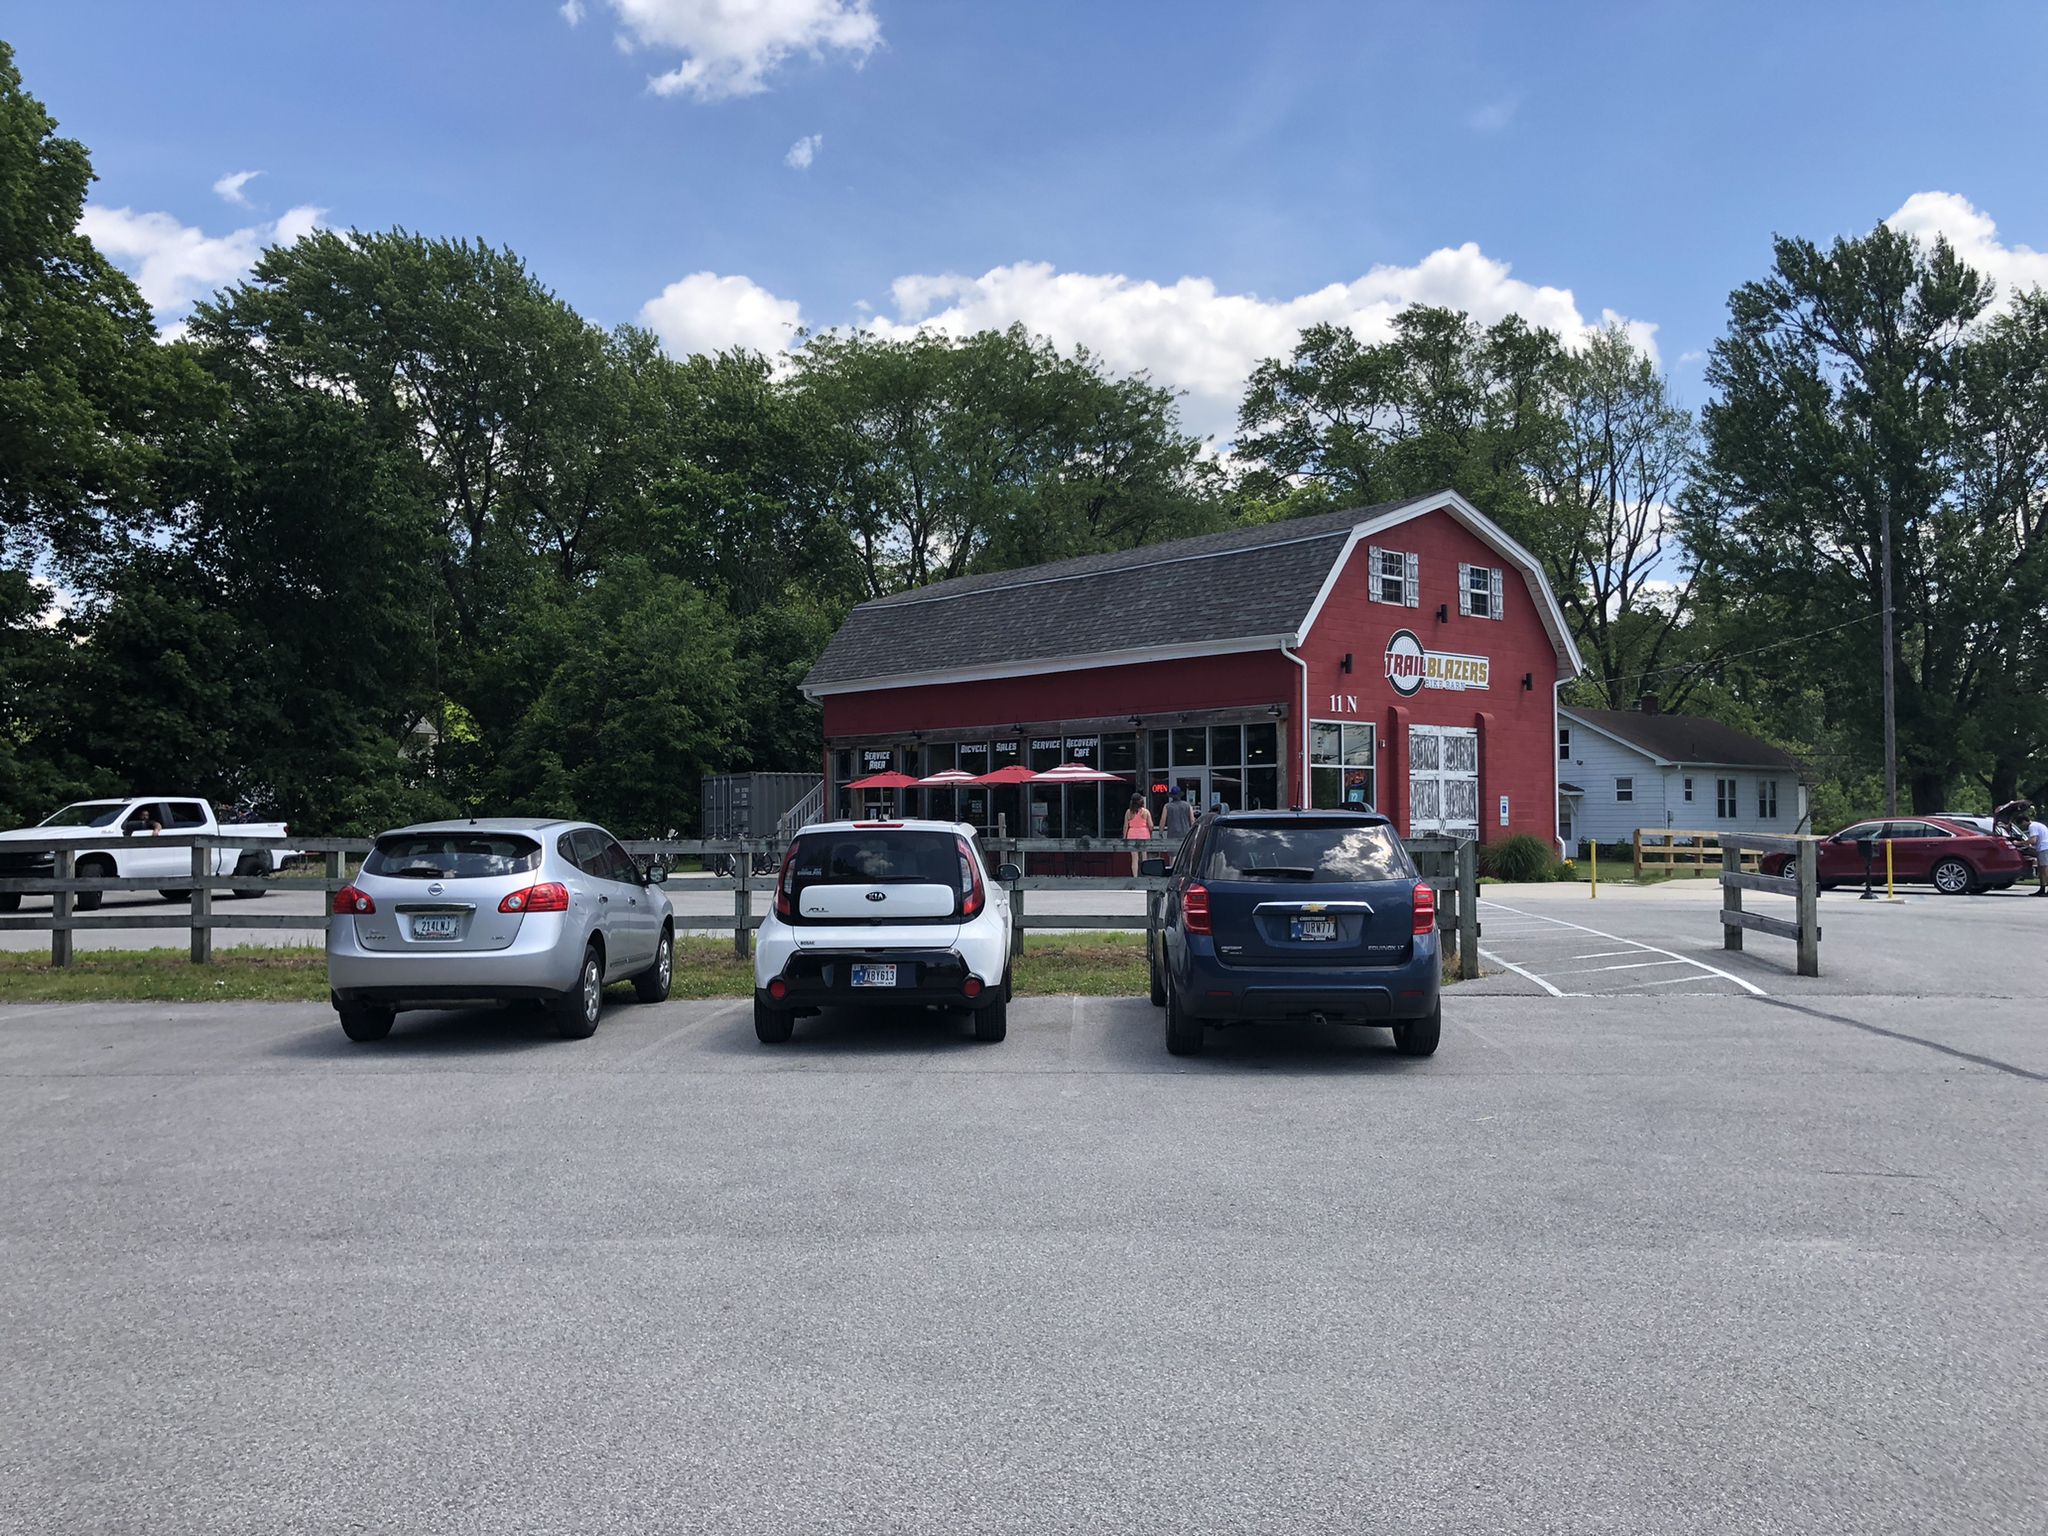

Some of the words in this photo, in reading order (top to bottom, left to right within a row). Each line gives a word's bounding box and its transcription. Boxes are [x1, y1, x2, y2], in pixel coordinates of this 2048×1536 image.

[1385, 652, 1426, 677] TRAIL
[1427, 657, 1488, 683] BLAZERS
[1330, 695, 1342, 713] 11
[1346, 696, 1358, 712] N
[961, 744, 987, 754] BICYCLE
[996, 743, 1017, 752] SALES
[1032, 741, 1061, 750] SERVICE
[1066, 738, 1098, 749] RECOVERY
[864, 751, 890, 760] SERVICE
[869, 760, 886, 770] AREA
[1152, 784, 1168, 793] OPEN
[421, 921, 451, 932] 214LNJ
